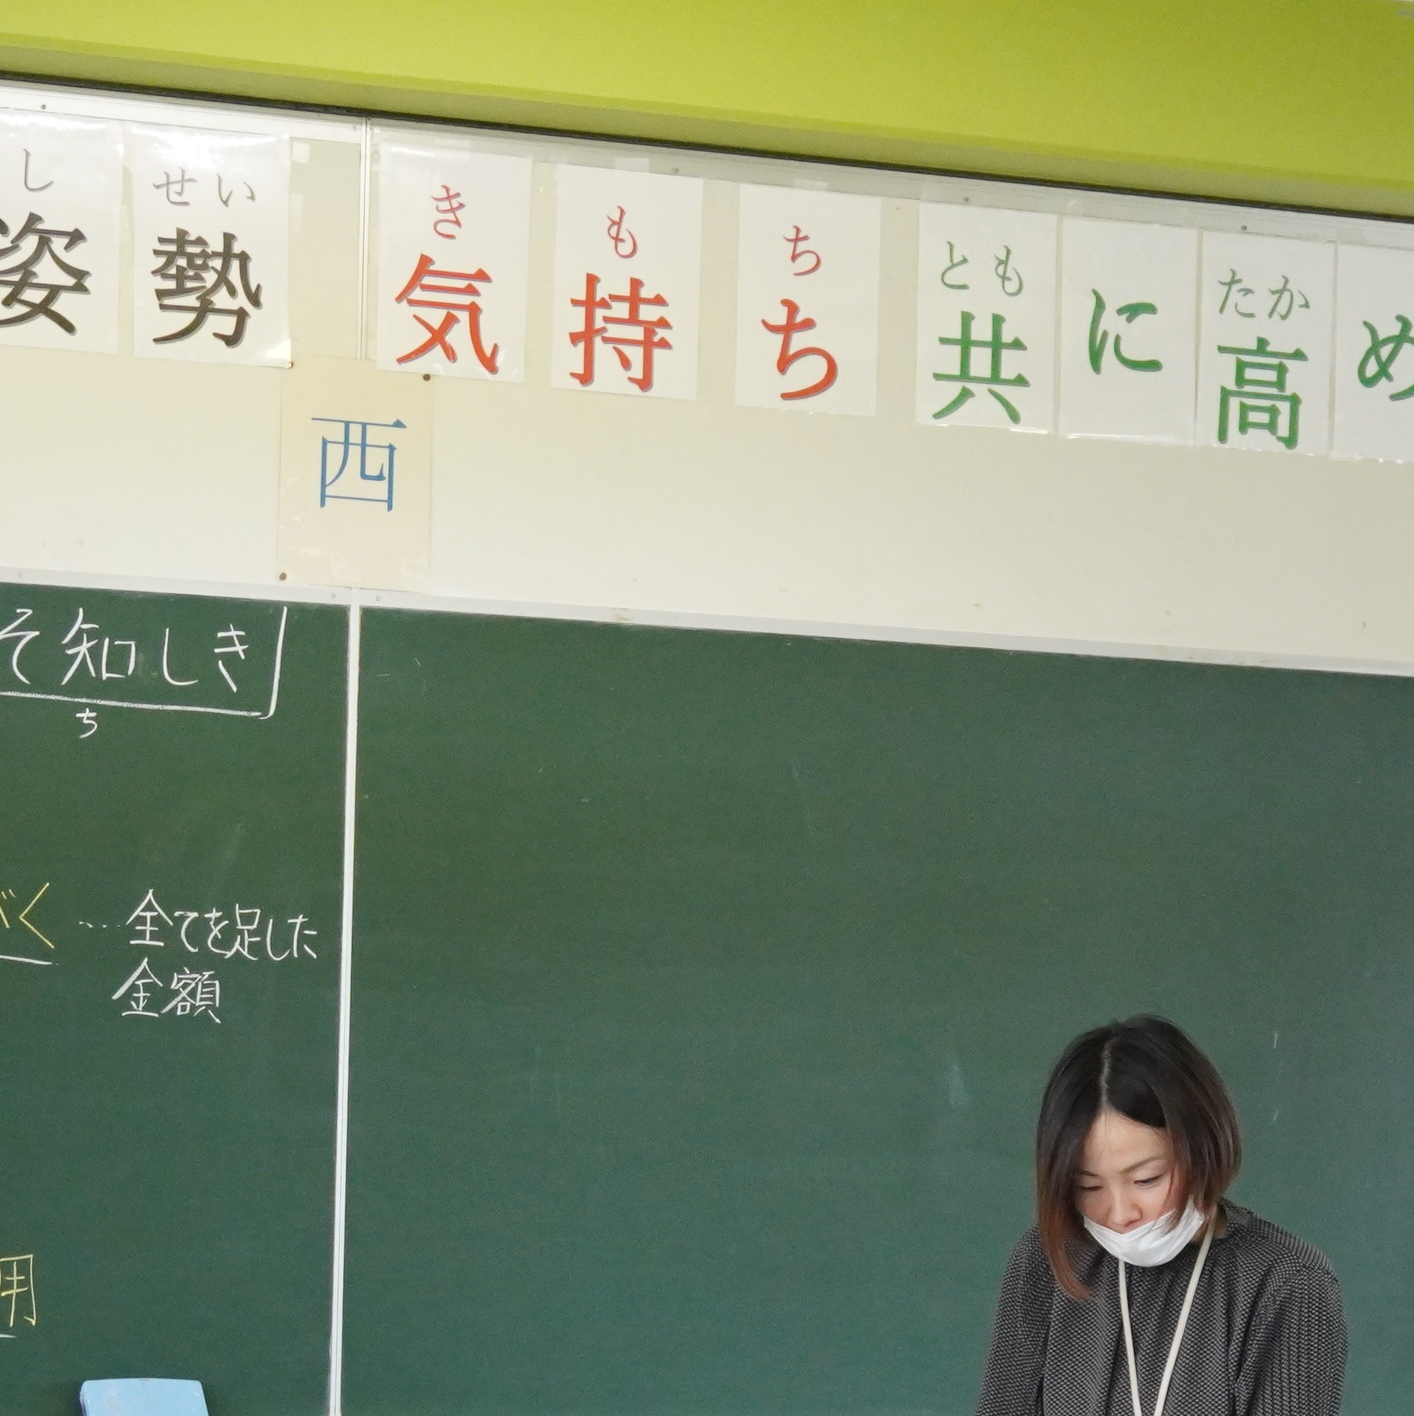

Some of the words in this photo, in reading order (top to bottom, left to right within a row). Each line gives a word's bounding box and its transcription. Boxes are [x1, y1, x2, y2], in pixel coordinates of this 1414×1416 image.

[21, 148, 55, 193] し
[152, 167, 257, 207] せい
[430, 182, 467, 242] き
[605, 206, 639, 259] も
[783, 224, 825, 277] ち
[940, 241, 1025, 297] とも
[1217, 267, 1311, 321] たか
[395, 253, 840, 402] 気持ち
[310, 417, 408, 513] 西
[76, 708, 98, 737] ち
[111, 957, 222, 1024] 金額
